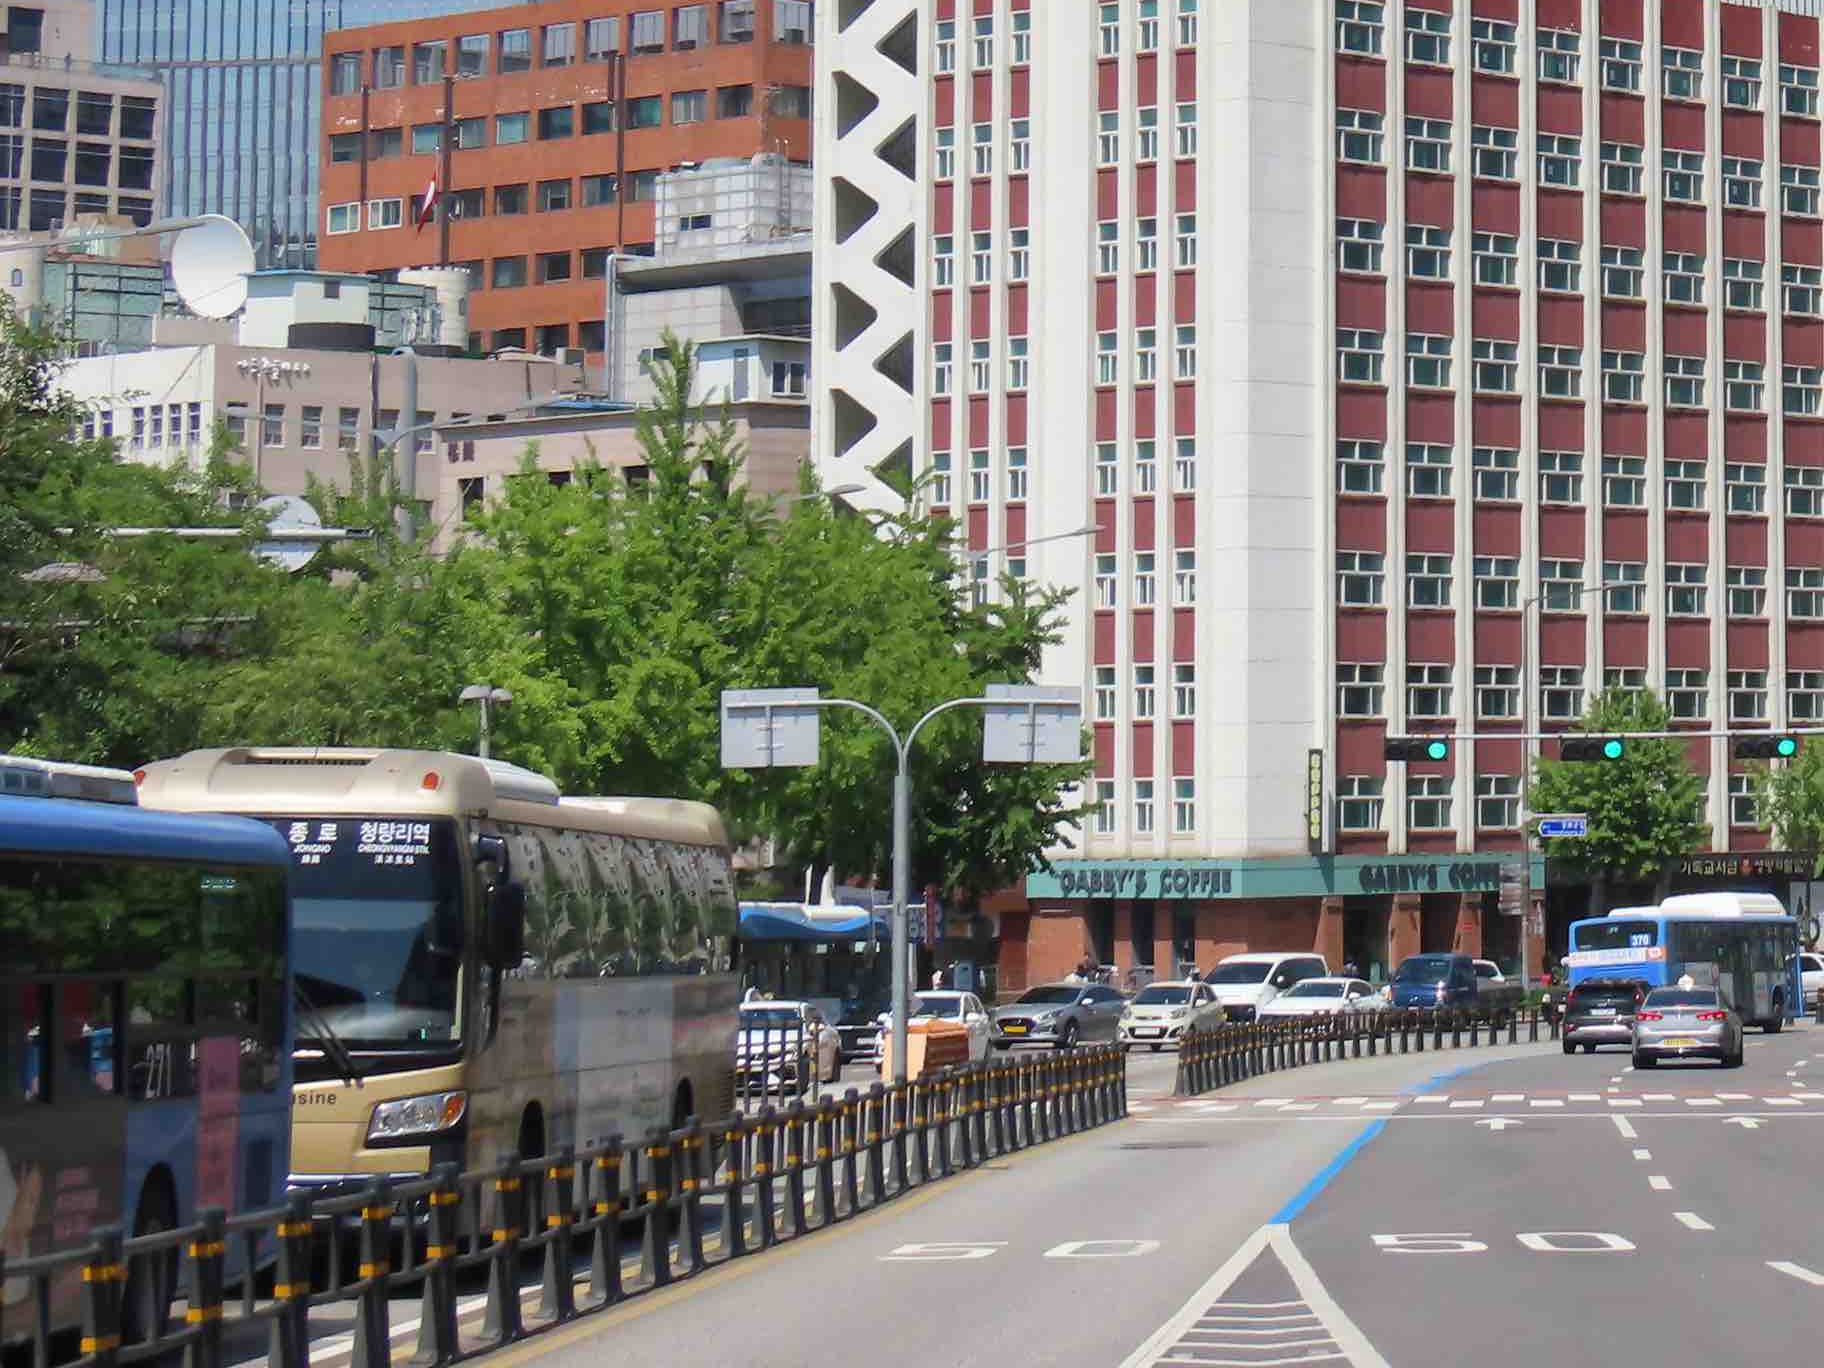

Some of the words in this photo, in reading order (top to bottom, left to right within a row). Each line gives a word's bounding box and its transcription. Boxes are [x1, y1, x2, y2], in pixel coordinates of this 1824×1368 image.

[360, 822, 431, 844] 청량리역
[1159, 868, 1233, 894] COFFEE
[1631, 934, 1649, 946] 370
[1370, 1232, 1637, 1253] 50
